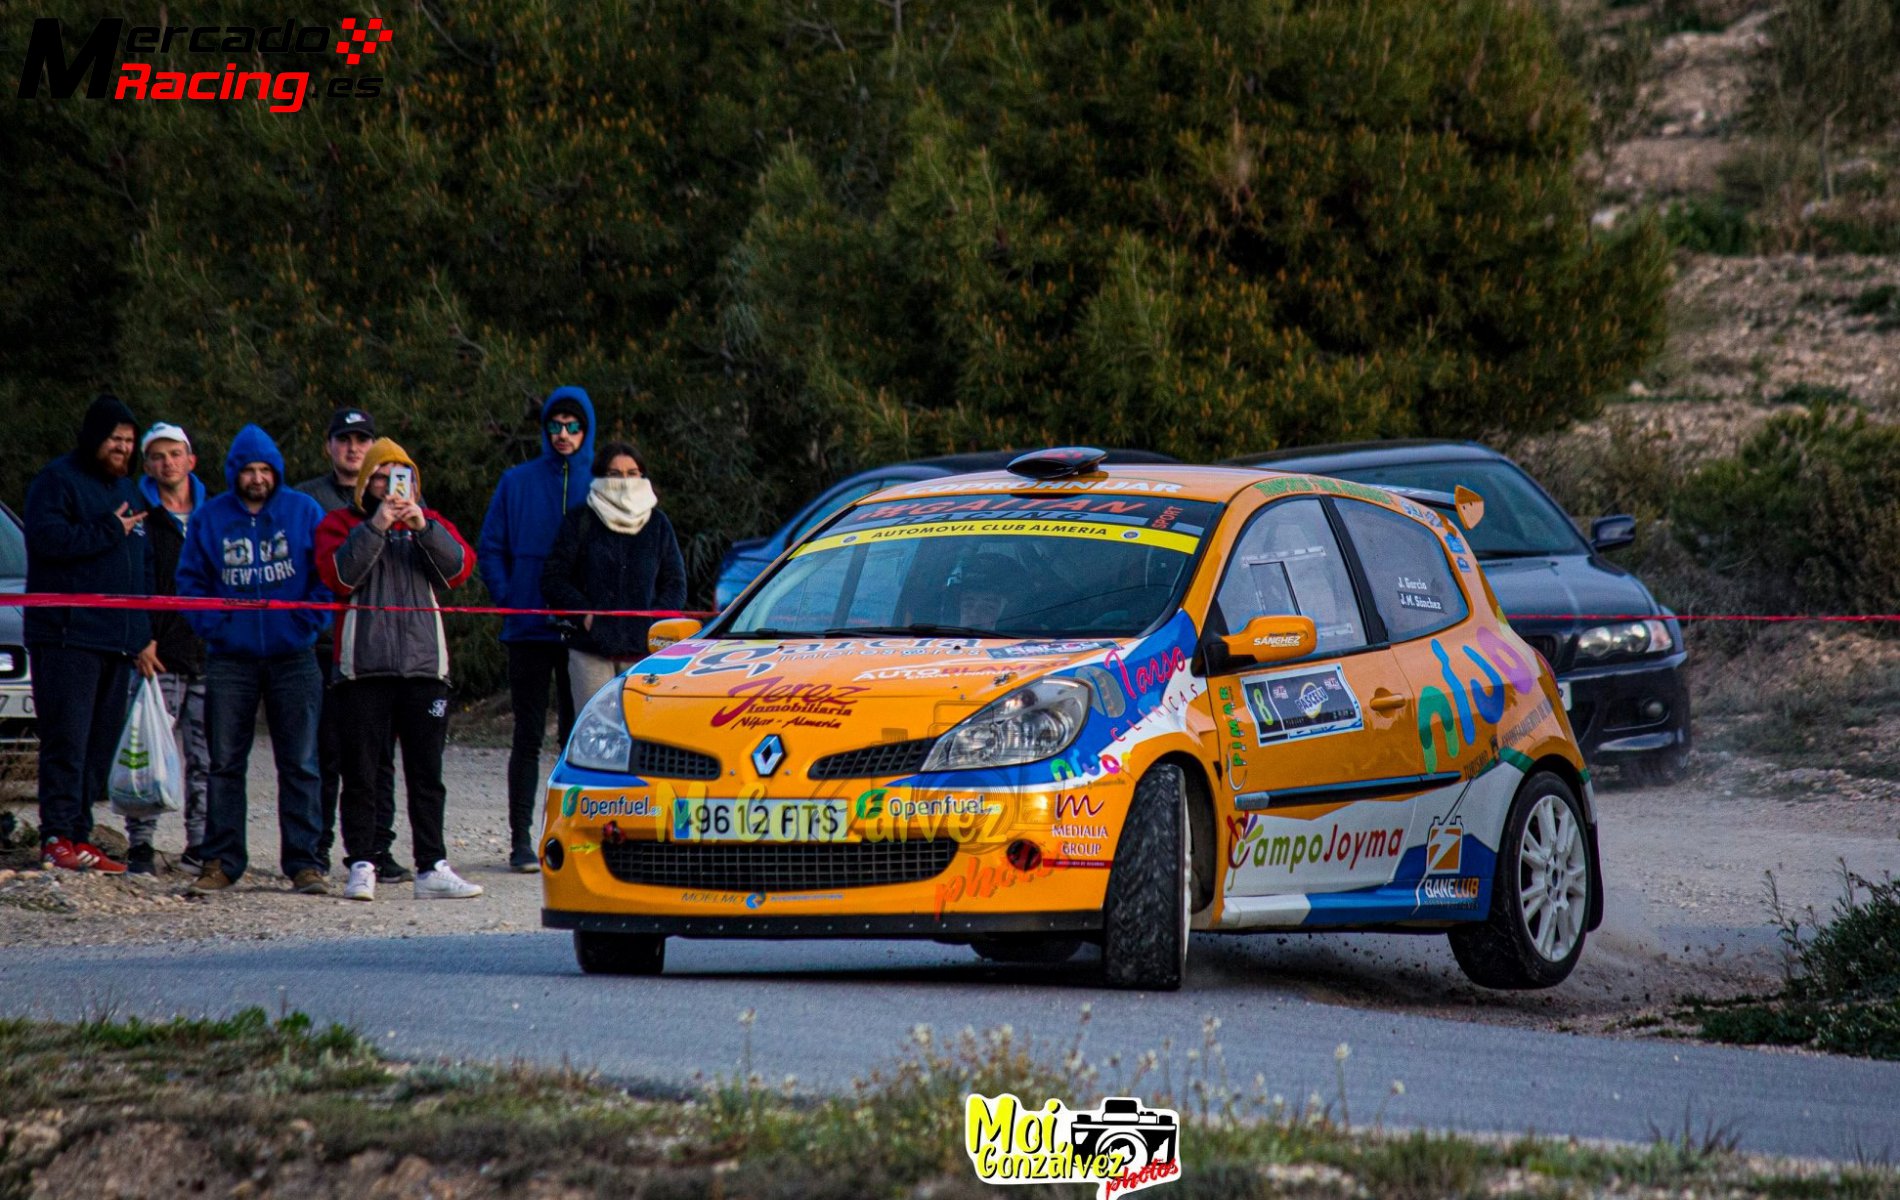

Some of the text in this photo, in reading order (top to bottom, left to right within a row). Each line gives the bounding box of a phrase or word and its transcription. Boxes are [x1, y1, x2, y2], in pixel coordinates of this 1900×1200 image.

[872, 523, 1107, 538] AUTOMOVIL CLUB ALMERIA
[895, 510, 1088, 526] RACING
[1151, 505, 1184, 530] SPORT
[222, 558, 296, 585] NEW YORK
[1104, 647, 1186, 700] Tarso
[711, 676, 871, 727] Jerez
[1110, 683, 1199, 742] CLINICAS
[1253, 688, 1274, 726] 8
[694, 805, 839, 835] 9612 FTS
[1052, 823, 1108, 839] MEDIALIA
[1062, 842, 1101, 856] GROUP
[1425, 877, 1479, 898] BANELUB
